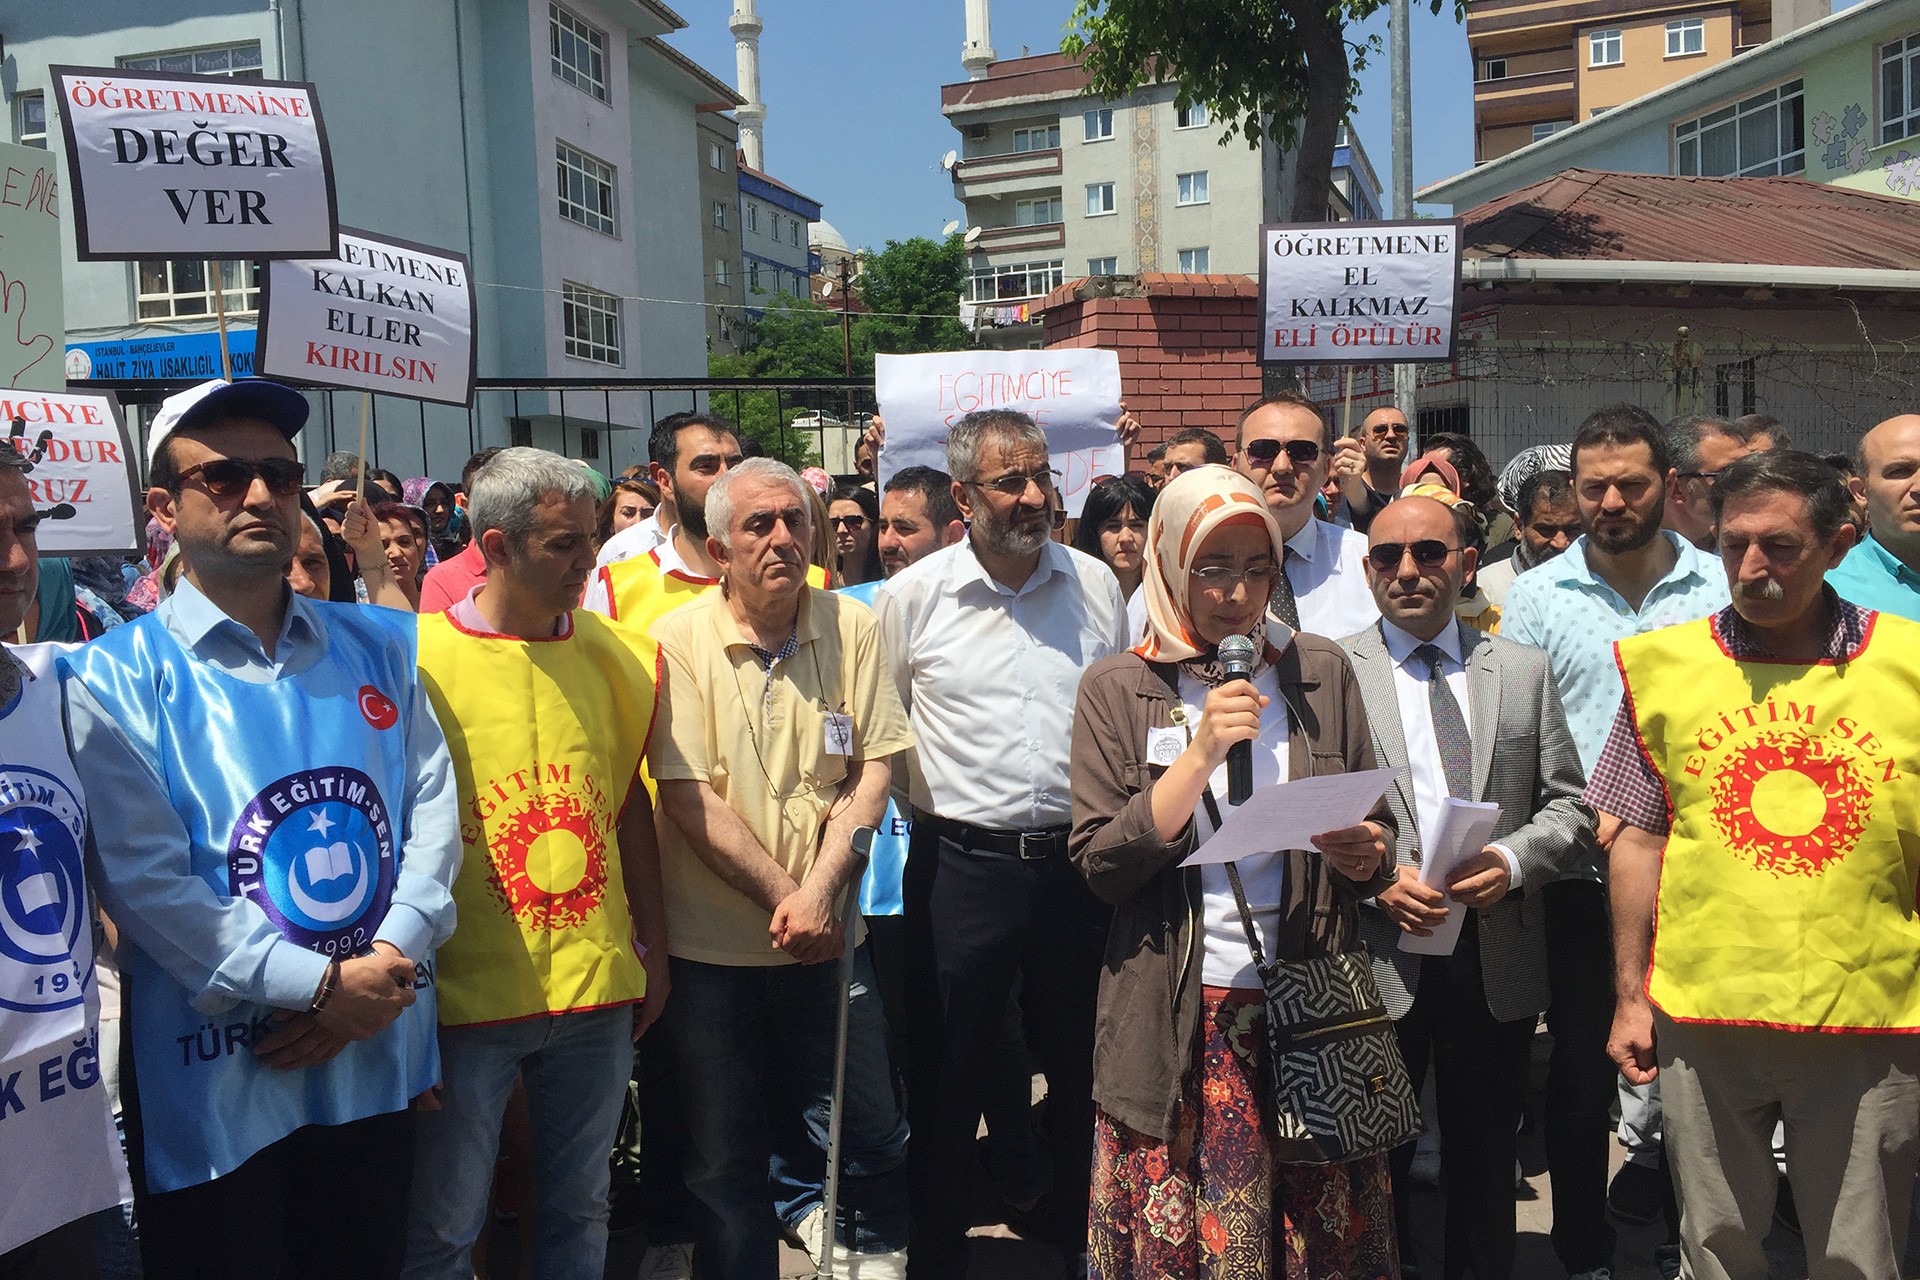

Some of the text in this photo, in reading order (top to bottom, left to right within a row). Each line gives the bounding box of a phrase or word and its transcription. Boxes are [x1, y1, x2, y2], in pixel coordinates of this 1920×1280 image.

[71, 80, 311, 119] ÖĞRETMENİNE
[109, 120, 296, 169] DEĞER
[163, 188, 273, 226] VER
[1273, 232, 1450, 258] ÖĞRETMENE
[340, 243, 462, 288] ETMENE
[1344, 266, 1378, 286] EL
[312, 268, 435, 315] KALKAN
[1290, 297, 1429, 317] KALKMAZ
[326, 307, 422, 347] ELLER
[1273, 323, 1318, 348] ELİ
[1331, 322, 1443, 347] ÖPÜLÜR
[305, 341, 437, 384] KIRILSIN
[44, 438, 123, 464] DUR
[1683, 696, 1903, 785] EĞİTİM SEN
[461, 760, 572, 847] EĞİTİM
[232, 812, 273, 897] TÜRK
[311, 927, 368, 958] 1992
